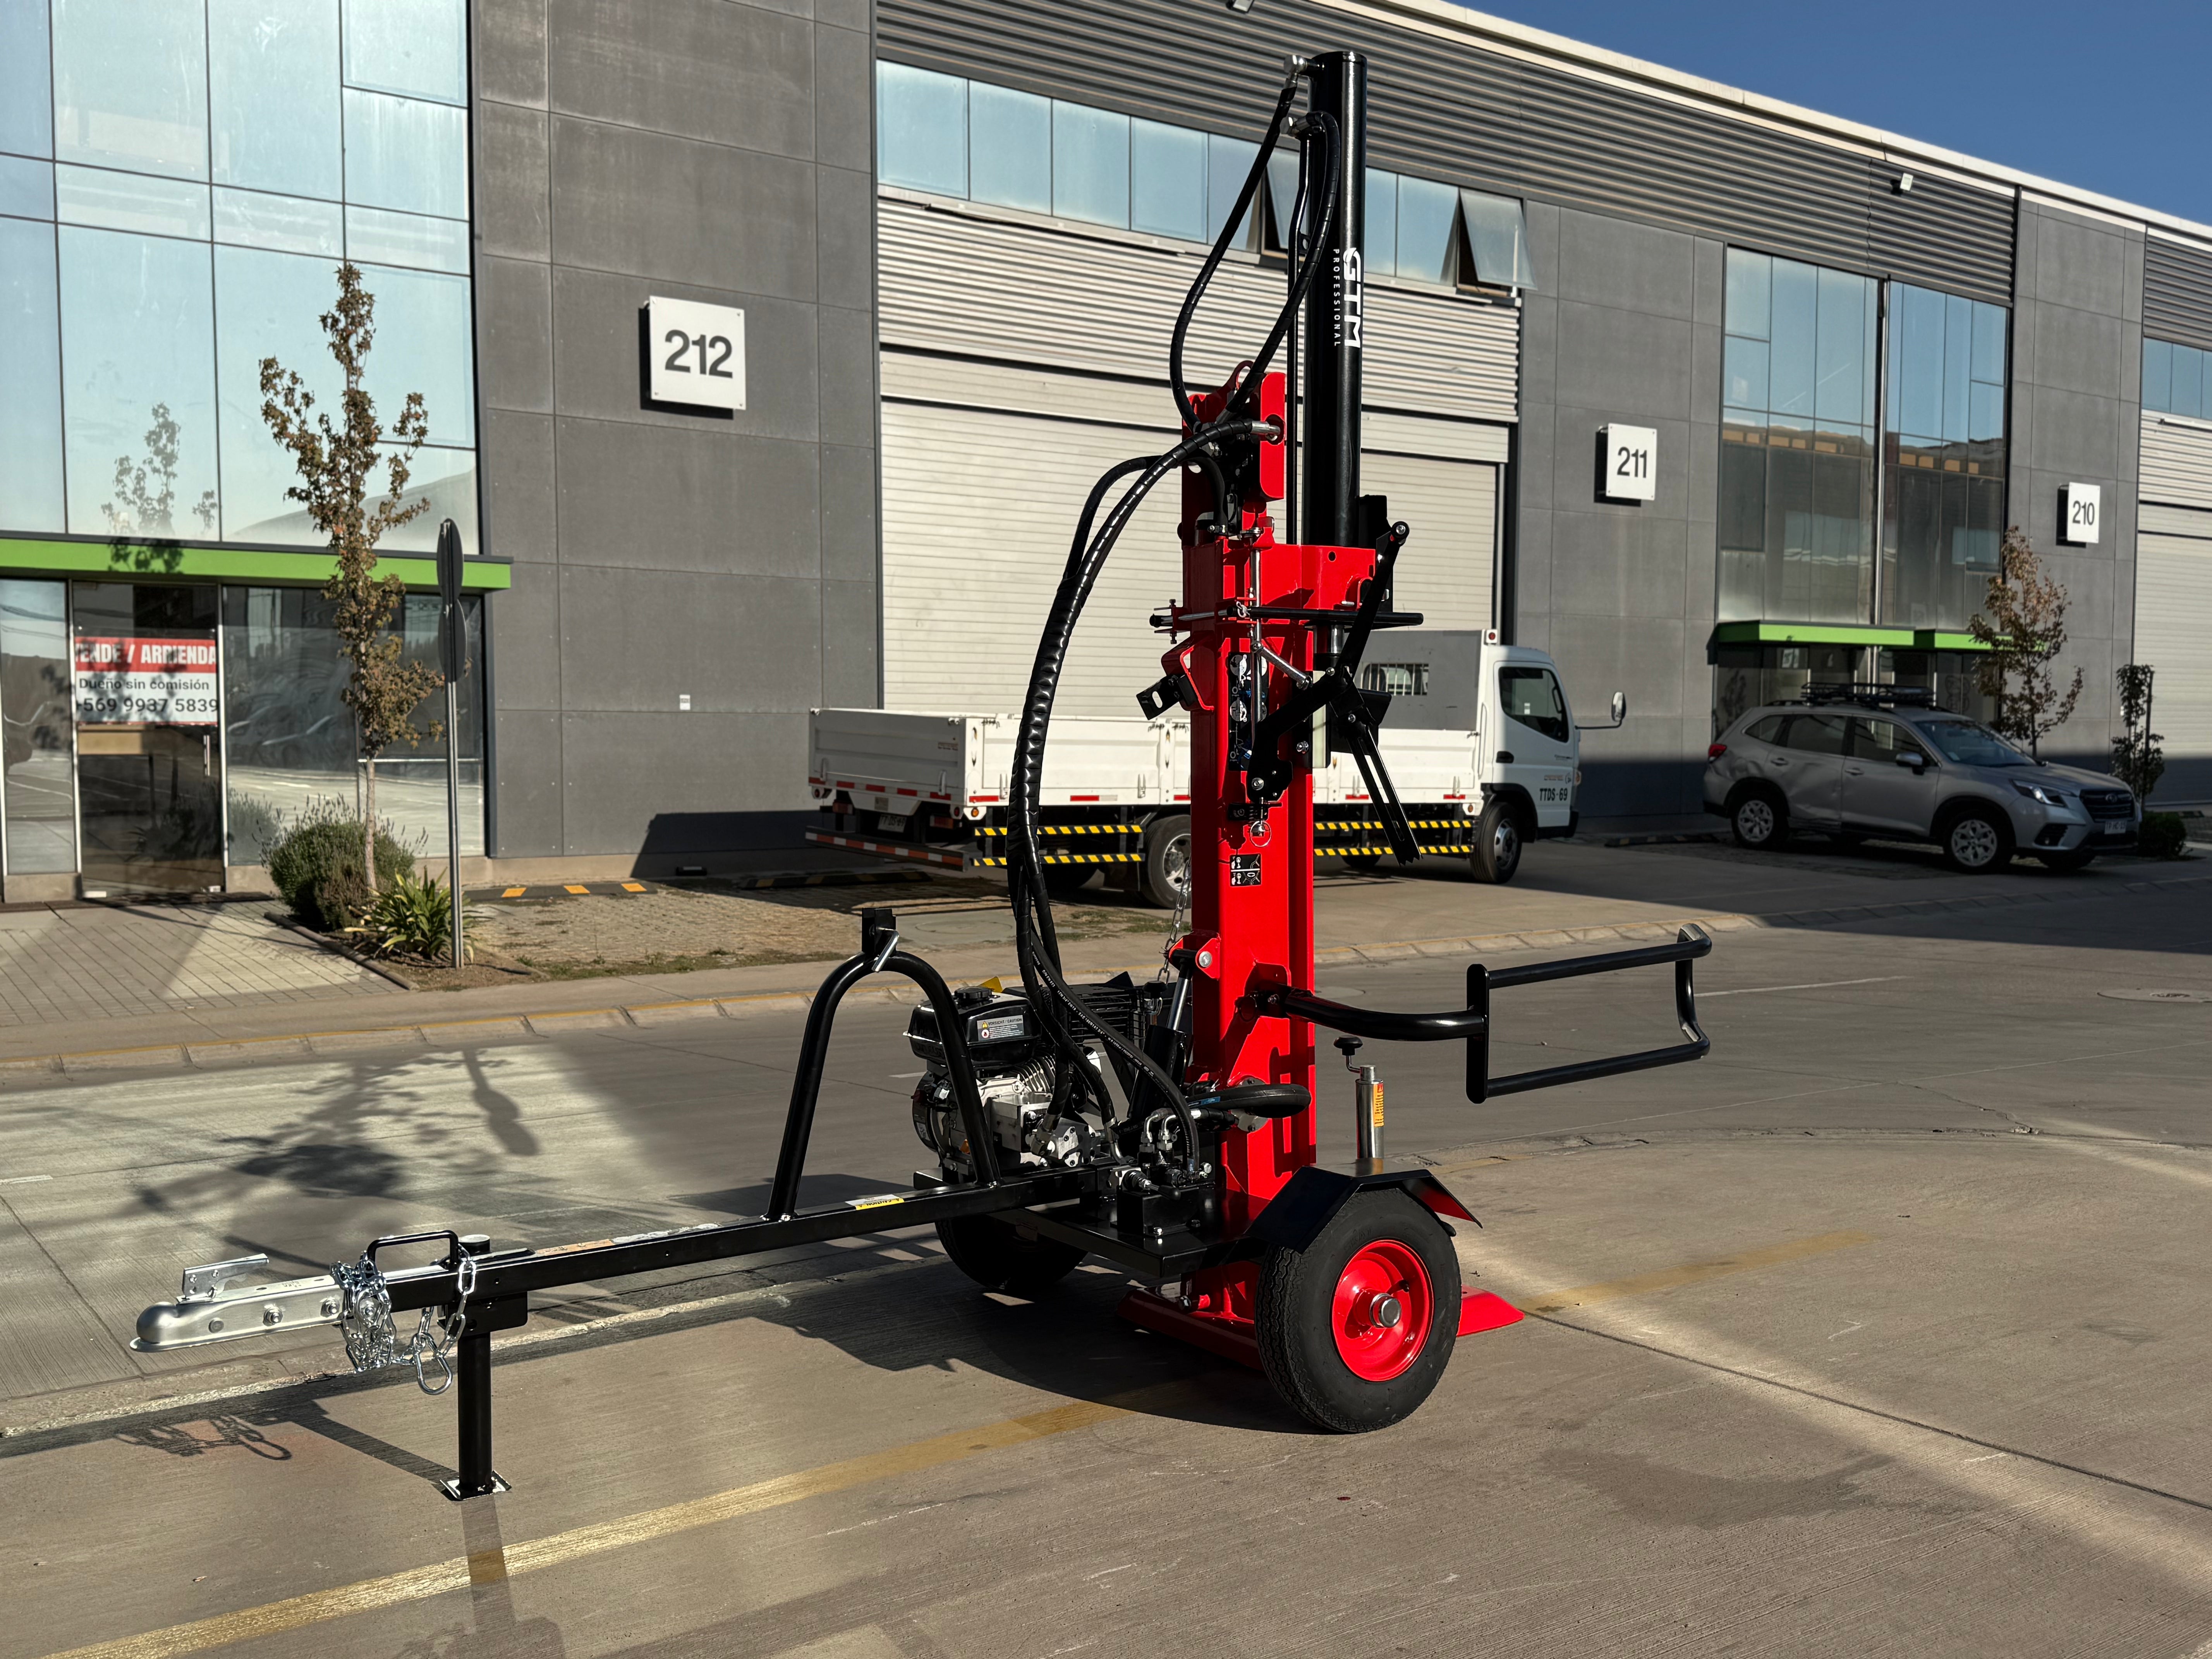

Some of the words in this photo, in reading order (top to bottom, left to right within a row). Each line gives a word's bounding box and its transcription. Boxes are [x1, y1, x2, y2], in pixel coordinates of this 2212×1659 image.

[1333, 249, 1341, 346] PROFESSIONAL
[1343, 247, 1361, 348] GTM
[665, 329, 733, 379] 212
[1617, 447, 1647, 478] 211
[2072, 500, 2095, 526] 210
[141, 645, 216, 665] ARRIENDA
[79, 678, 121, 689] Dueño
[126, 678, 145, 689] sin
[150, 679, 209, 690] comisión
[124, 698, 168, 712] 9937
[175, 699, 218, 712] 5839
